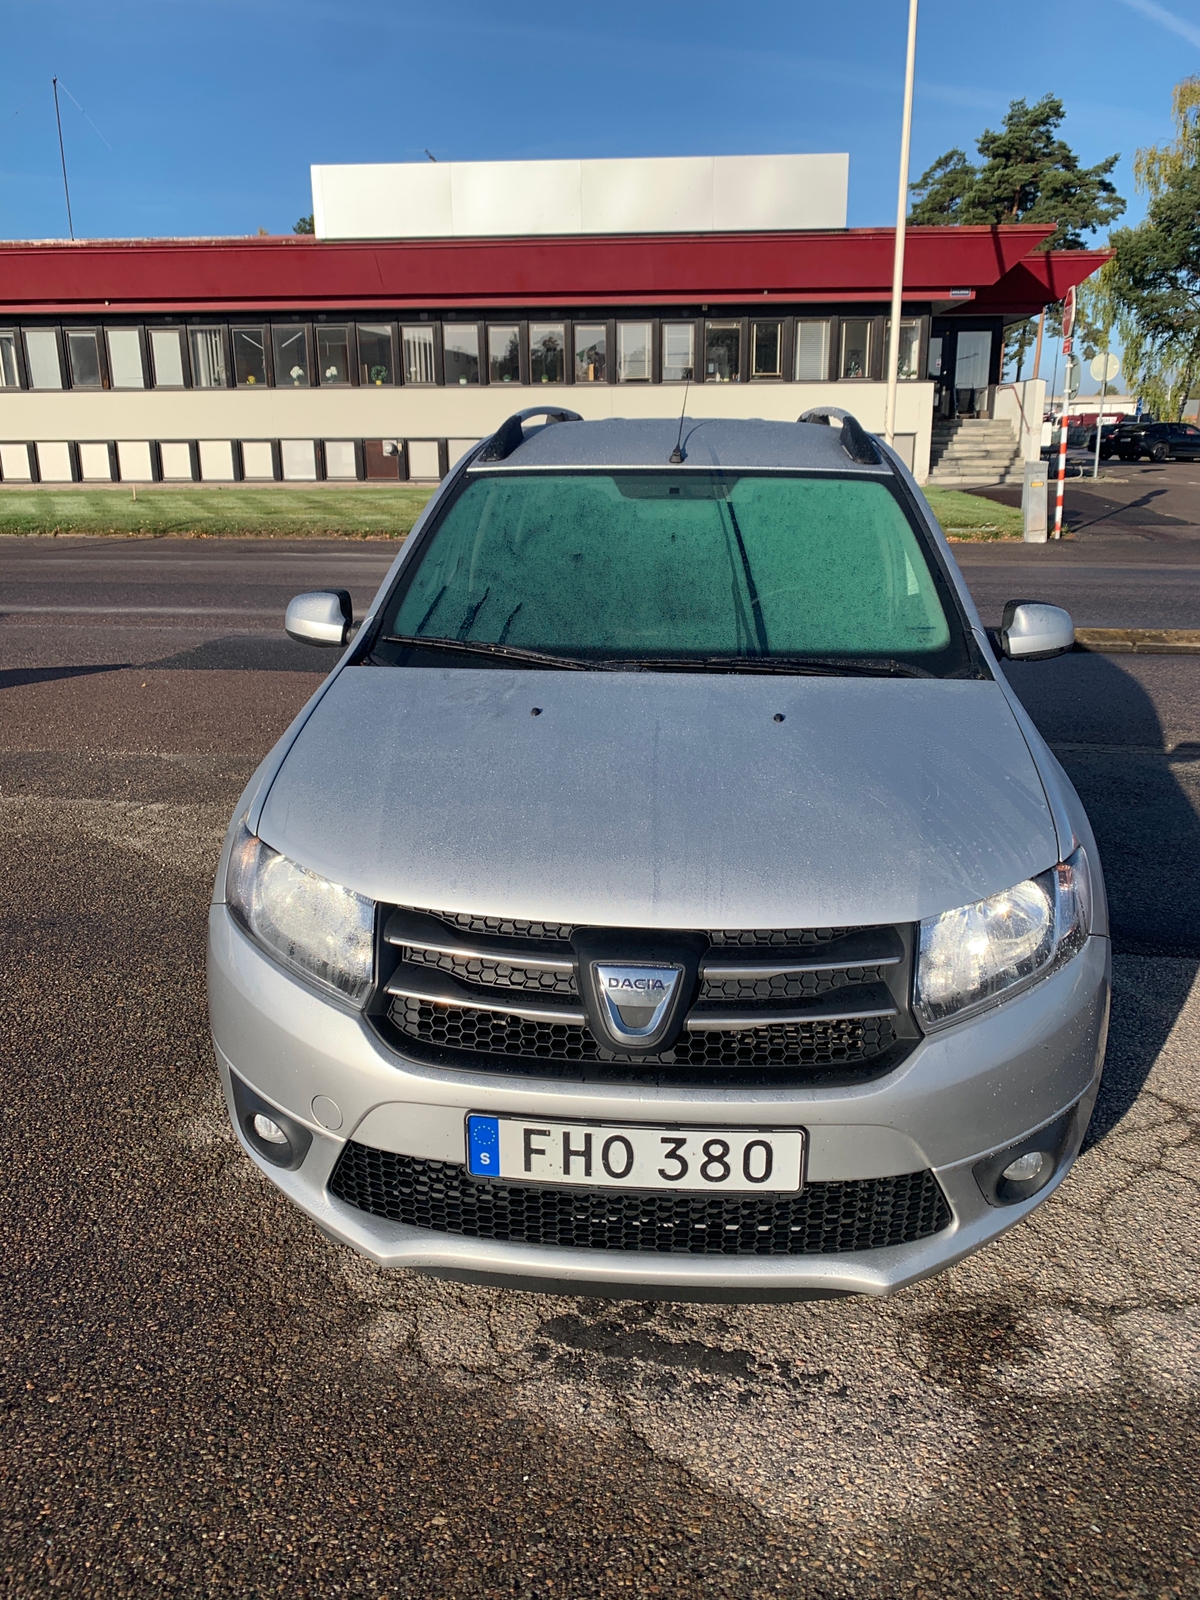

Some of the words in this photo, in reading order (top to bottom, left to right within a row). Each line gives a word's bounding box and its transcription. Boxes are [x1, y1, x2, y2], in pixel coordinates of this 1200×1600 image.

[608, 977, 665, 991] DACIA
[479, 1152, 491, 1165] S
[523, 1127, 635, 1179] FHO
[657, 1136, 774, 1184] 380
